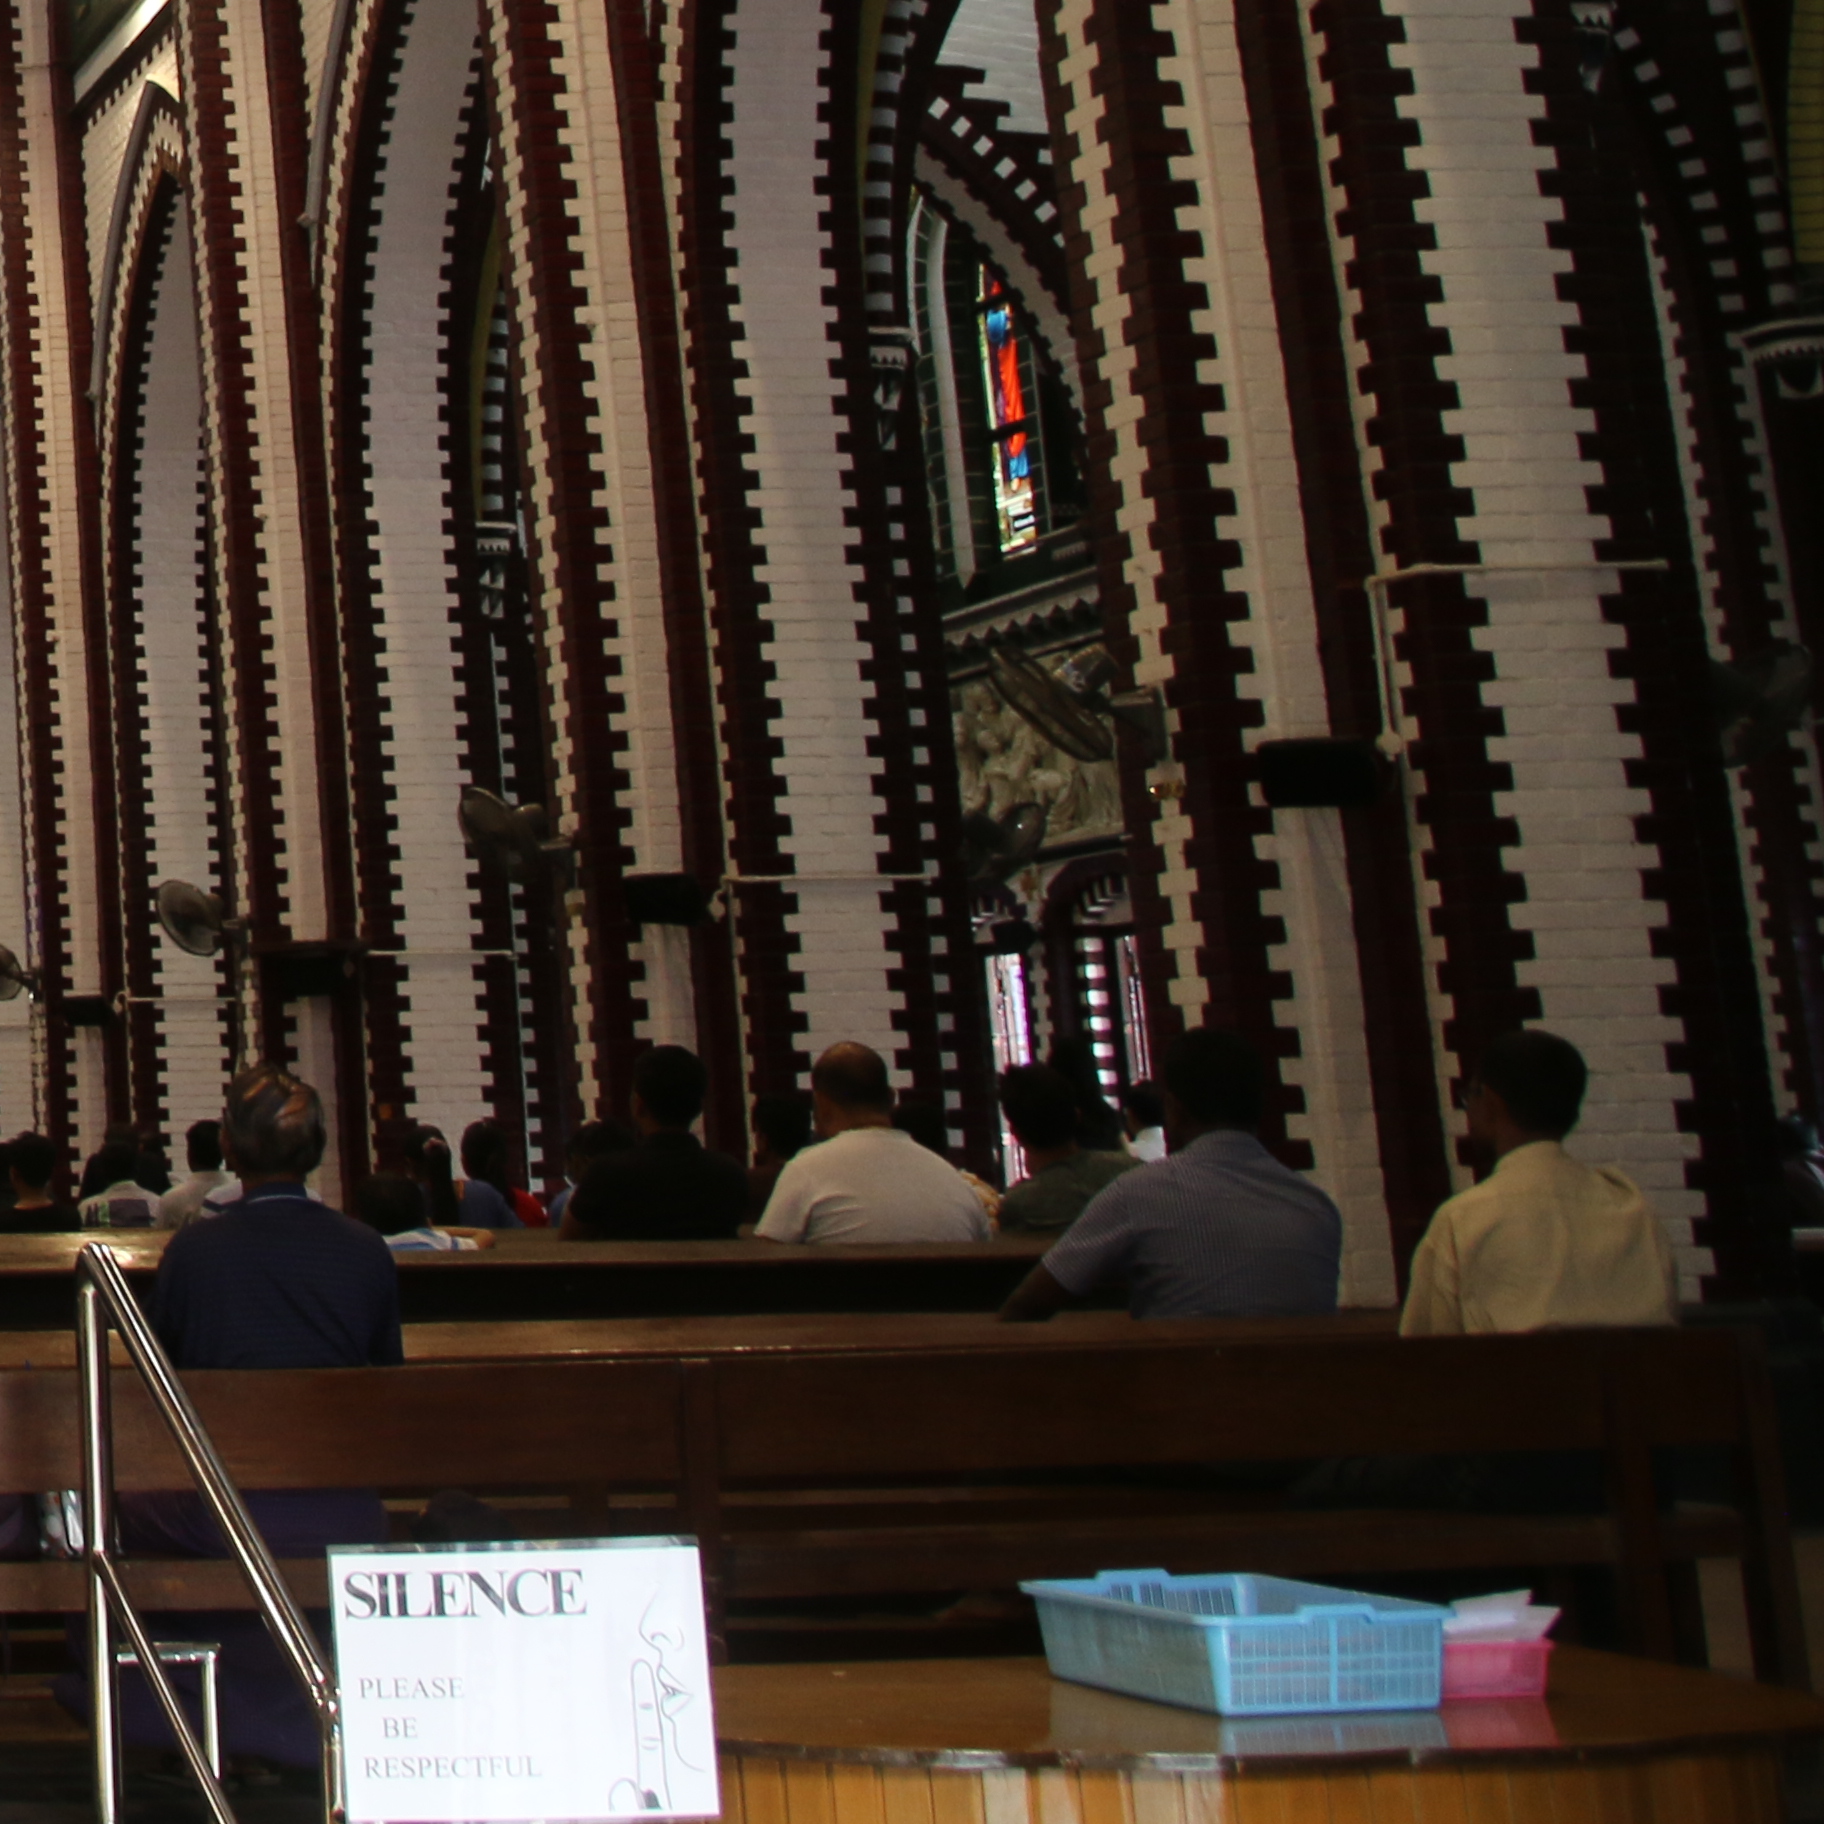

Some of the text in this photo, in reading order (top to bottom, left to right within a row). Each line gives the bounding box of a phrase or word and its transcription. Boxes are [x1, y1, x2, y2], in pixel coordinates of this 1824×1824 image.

[344, 1568, 588, 1619] SILENCE
[358, 1677, 465, 1699] PLEASE
[382, 1716, 419, 1739] BE
[364, 1755, 541, 1779] RESPECTFUL
